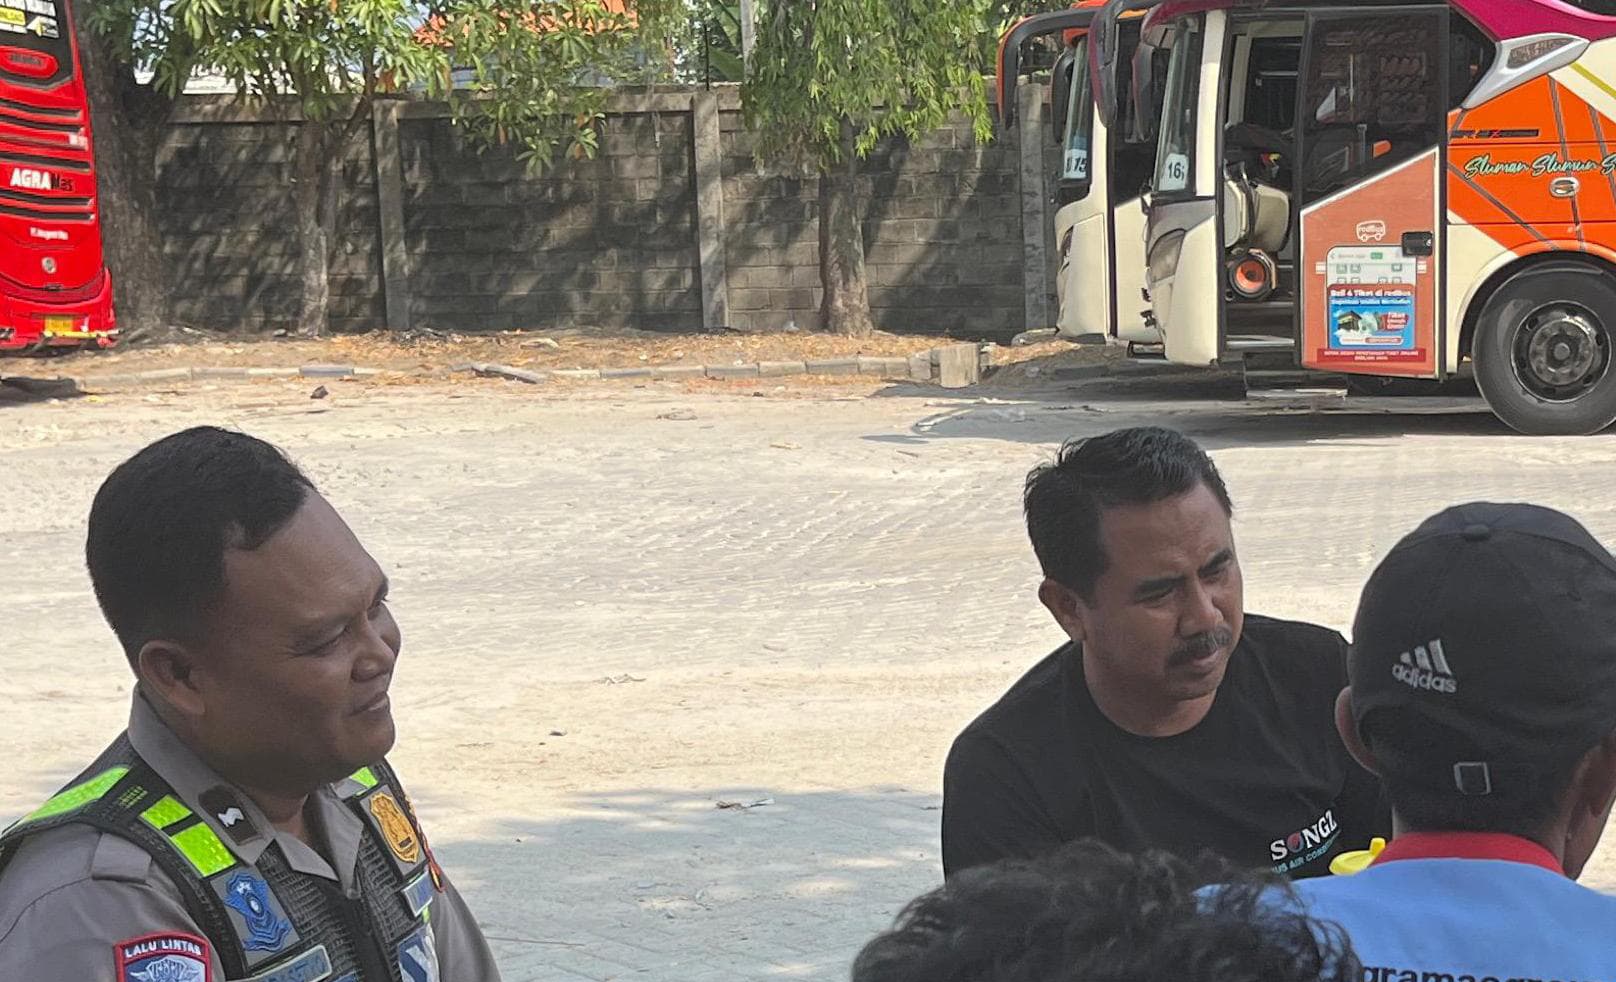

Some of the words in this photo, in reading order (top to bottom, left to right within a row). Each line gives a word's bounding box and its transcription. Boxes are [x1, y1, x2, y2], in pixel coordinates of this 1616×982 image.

[1391, 663, 1457, 693] adidas
[125, 941, 157, 959] LALU
[161, 938, 202, 956] LINTAS
